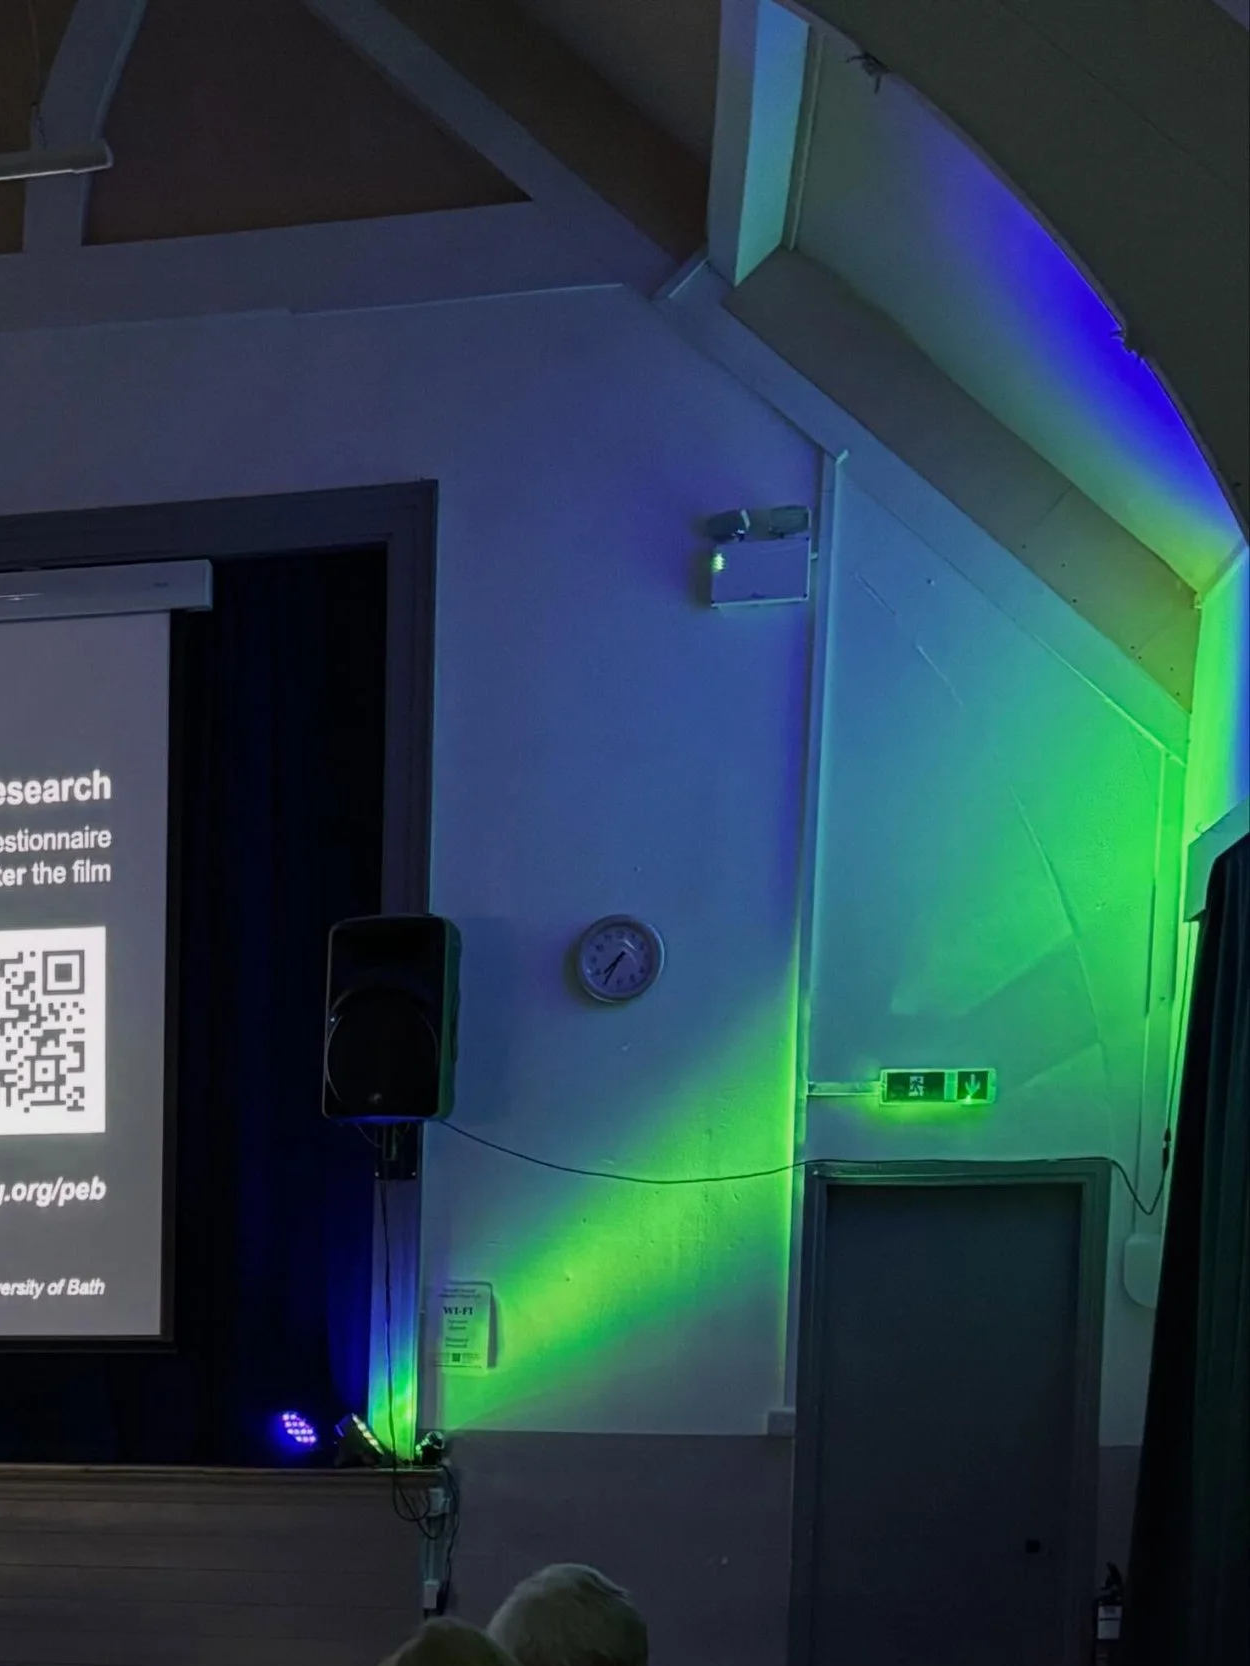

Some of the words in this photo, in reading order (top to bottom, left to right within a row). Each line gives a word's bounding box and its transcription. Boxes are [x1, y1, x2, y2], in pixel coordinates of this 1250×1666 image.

[31, 861, 66, 885] the
[72, 859, 111, 883] film
[47, 1279, 65, 1295] of
[67, 1278, 105, 1295] Bath
[443, 1306, 473, 1315] WI-FI
